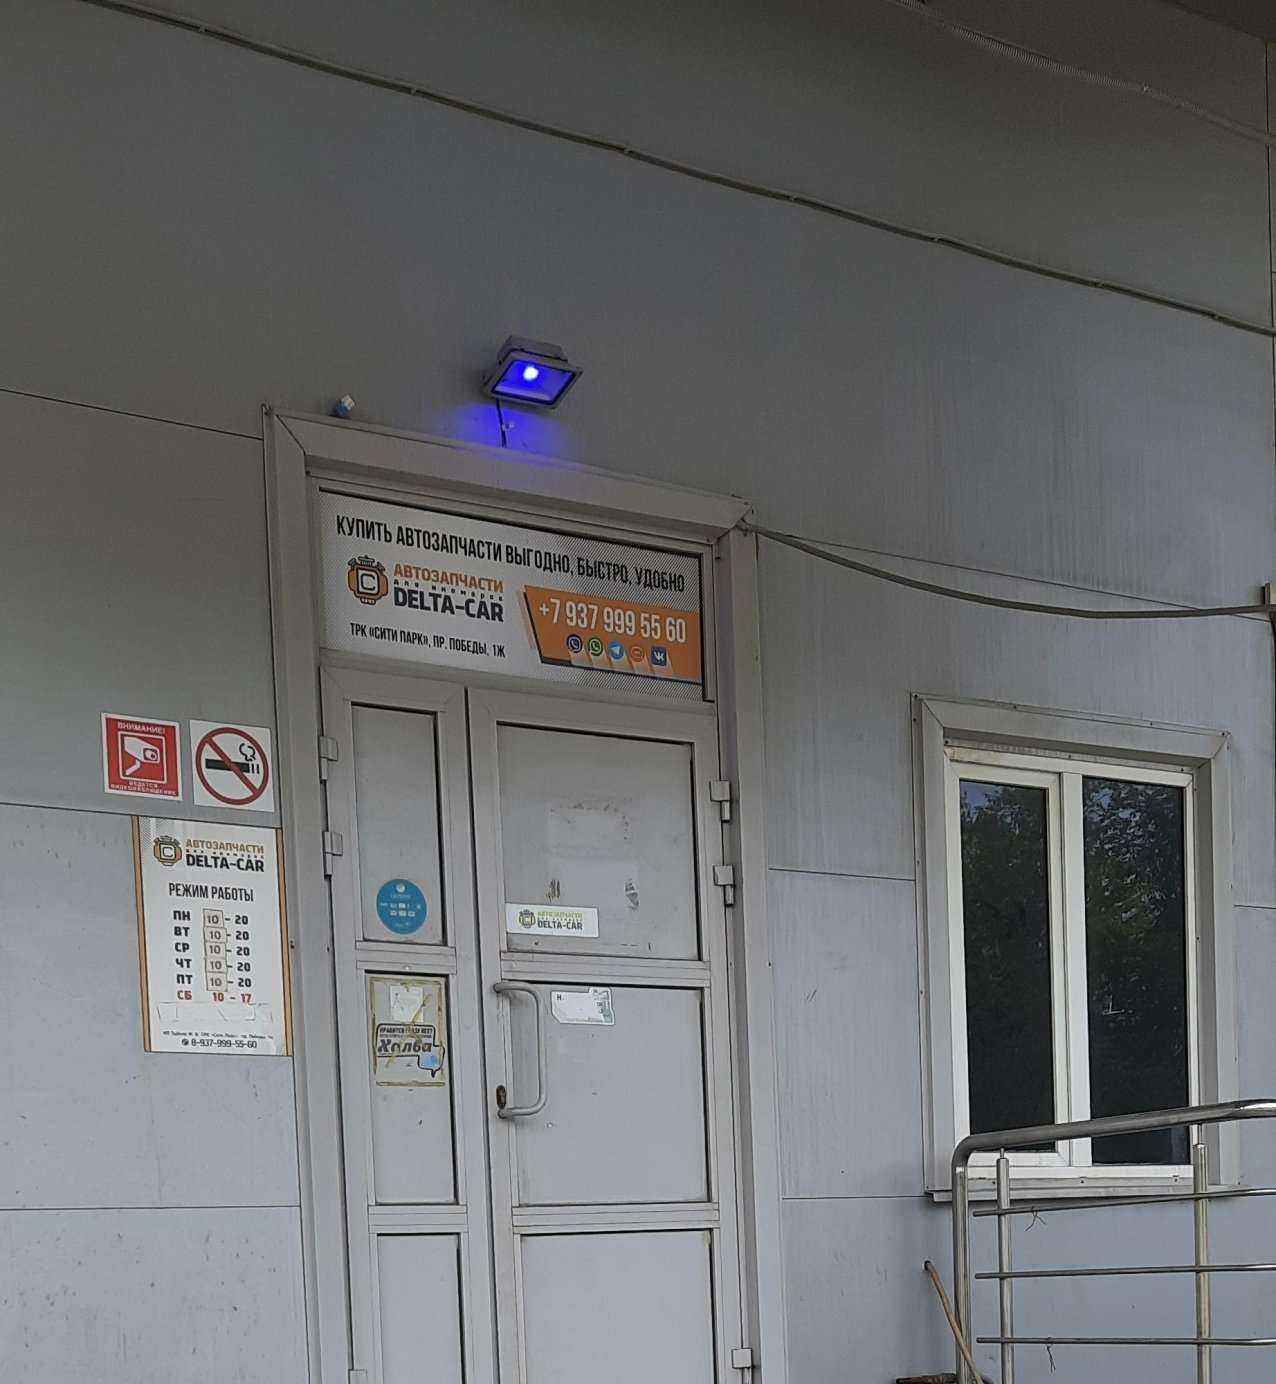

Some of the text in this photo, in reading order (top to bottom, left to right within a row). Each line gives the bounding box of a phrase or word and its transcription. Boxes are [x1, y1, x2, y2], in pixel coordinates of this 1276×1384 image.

[336, 515, 685, 592] КУПИТЬ АВТОЗАПЧАСТИ ВЫГОДНО, БЫСТРО, УДОБНО
[393, 563, 504, 593] АВТОЗАПЧАСТИ
[393, 586, 504, 622] DELTA-CAR
[539, 597, 686, 643] +7 937 999 55 60
[350, 622, 367, 638] ТРК
[369, 626, 398, 643] «СИТИ
[400, 630, 431, 648] ПАРК»,
[433, 635, 448, 650] ПР.
[492, 644, 506, 658] 1Ж
[186, 838, 264, 854] АВТОЗАПЧАСТИ
[186, 854, 265, 872] DELTA-CAR
[169, 882, 254, 902] РЕЖИМ РАБОТЫ
[173, 910, 191, 921] ПН
[207, 914, 219, 924] 10
[235, 914, 249, 925] 20
[537, 919, 583, 930] DELTA-CAR
[174, 926, 190, 937] ВТ
[209, 930, 221, 940] 10
[236, 930, 249, 941] 20
[174, 942, 190, 953] СР
[209, 945, 221, 954] 10
[236, 946, 250, 956] 20
[176, 958, 192, 969] ЧТ
[210, 960, 222, 970] 10
[237, 962, 251, 972] 20
[176, 974, 193, 985] ПТ
[210, 977, 222, 987] 10
[238, 977, 252, 988] 20
[177, 990, 192, 1000] СБ
[213, 992, 224, 1002] 10
[240, 993, 251, 1003] 17
[191, 1037, 258, 1048] 8-937-999-55-60
